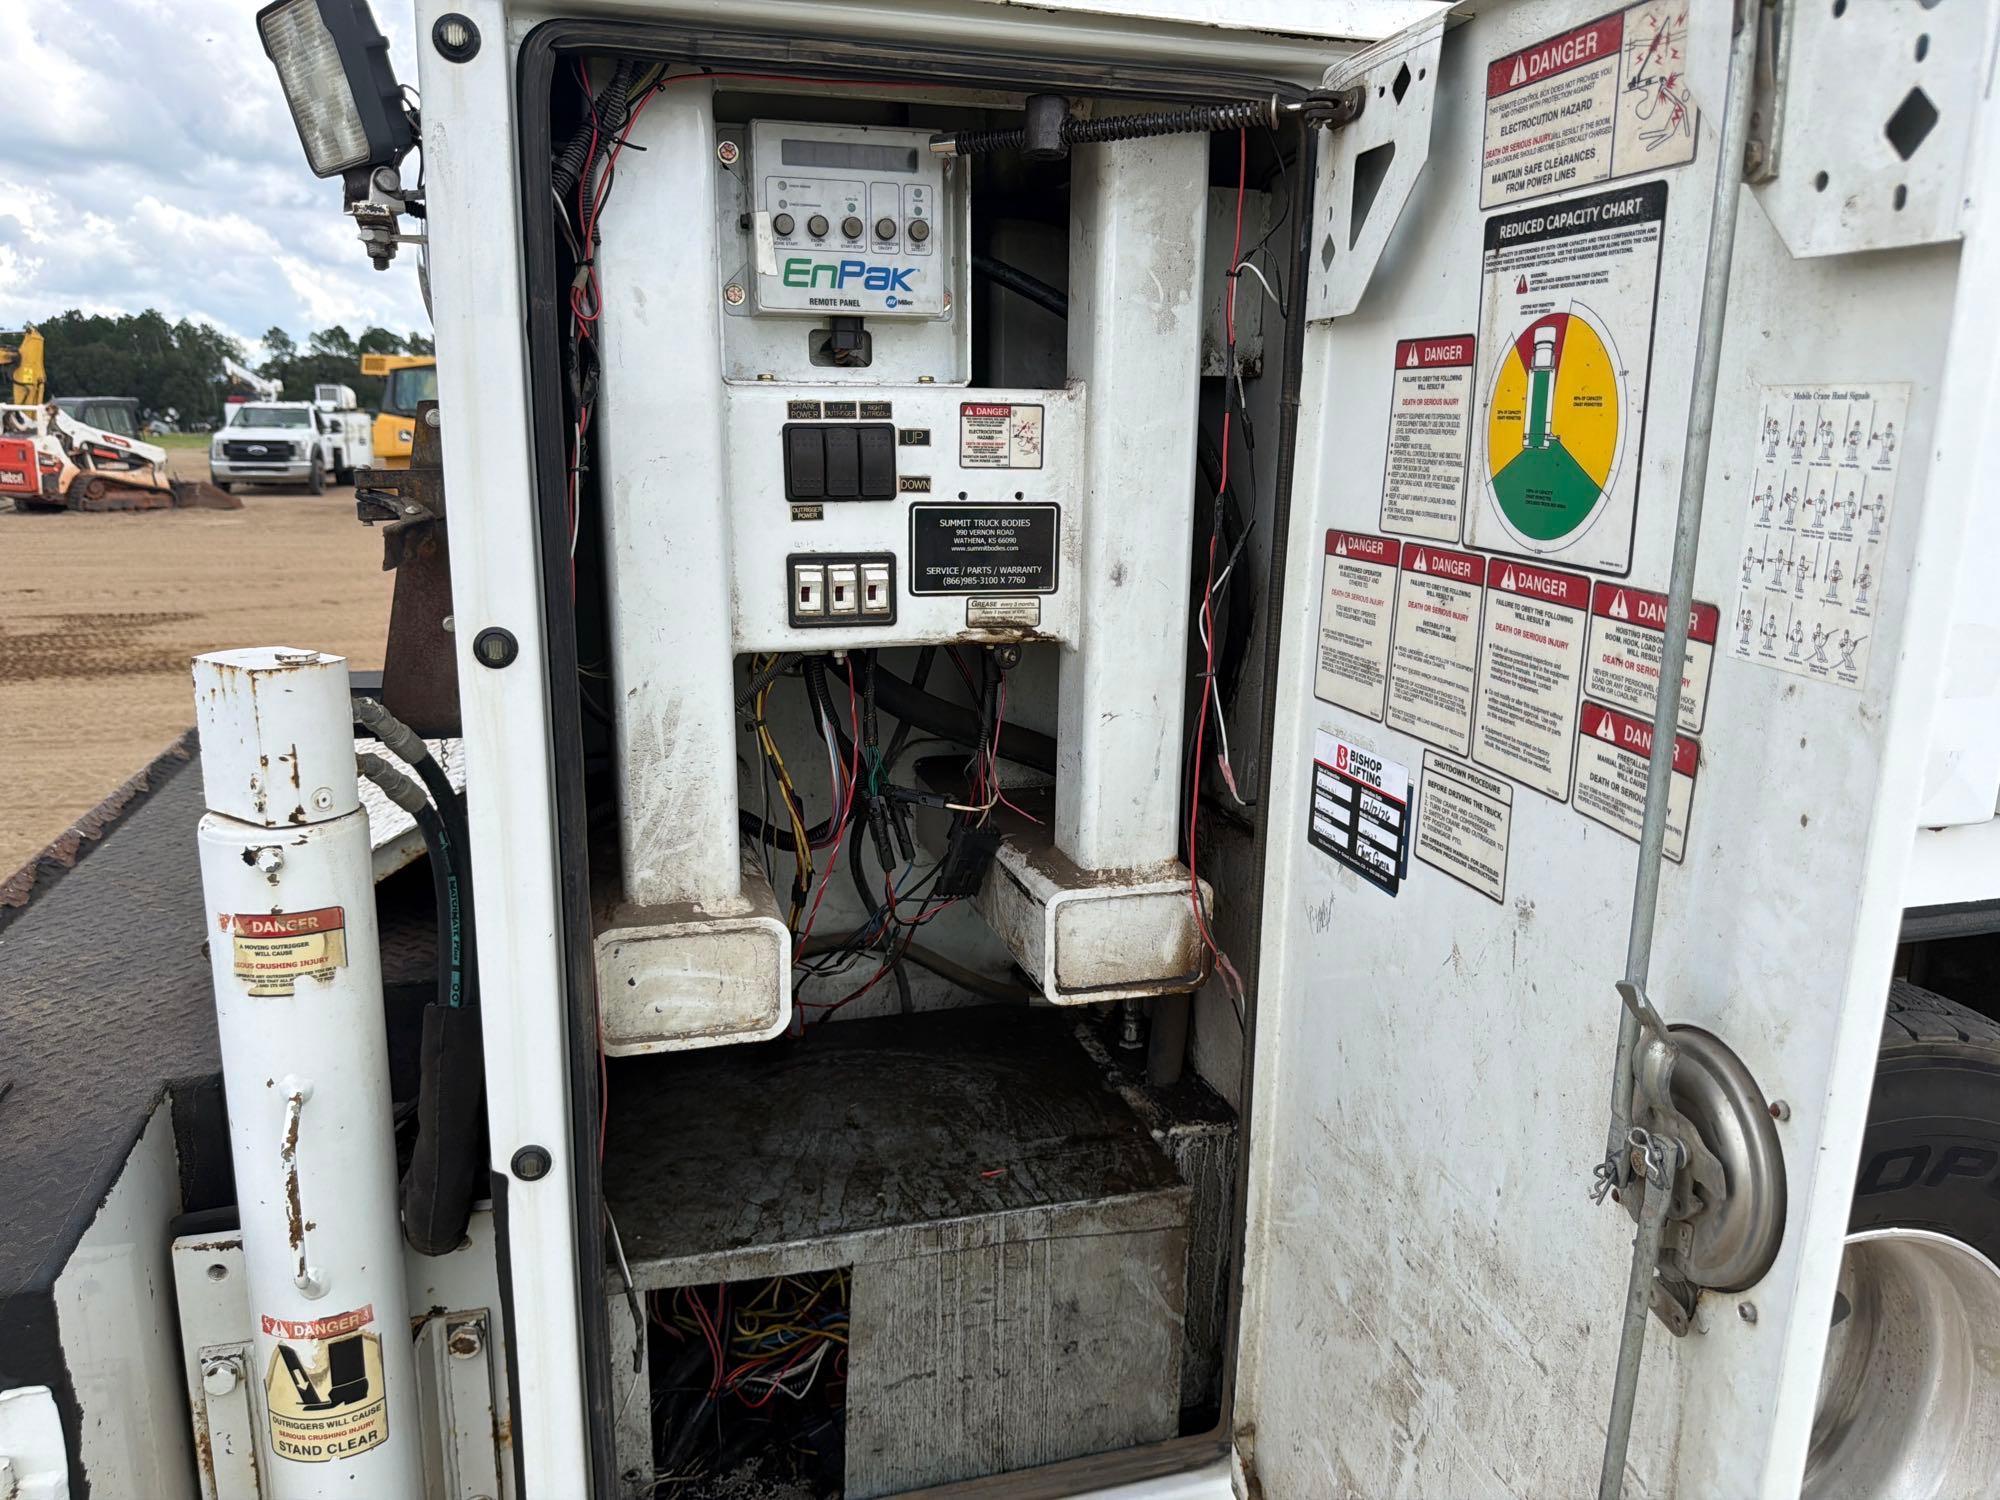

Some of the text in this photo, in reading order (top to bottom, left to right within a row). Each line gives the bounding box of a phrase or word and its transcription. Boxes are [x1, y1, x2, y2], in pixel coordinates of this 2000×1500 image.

[1529, 30, 1598, 76] DANGER
[1500, 97, 1592, 137] ELECTROCUTION HAZARD
[1485, 137, 1531, 159] DEATH OR SERIOUS
[1491, 146, 1595, 184] MAINTAIN SAFE CLEARANCES
[1505, 180, 1525, 194] FROM
[1526, 172, 1553, 189] POWER
[1554, 166, 1576, 182] LINES
[1499, 196, 1643, 240] REDUCED CAPACITY CHART
[783, 258, 916, 292] EnPak
[809, 298, 861, 307] REMOTE PANEL
[1423, 345, 1463, 361] DANGER
[1793, 391, 1870, 401] Mobile Crane Hand Signals
[905, 432, 923, 444] UP
[900, 480, 930, 489] DOWN
[1347, 536, 1383, 555] DANGER
[926, 567, 959, 575] SERVICE
[1000, 566, 1042, 574] WARRANTY
[1431, 556, 1471, 577] DANGER
[943, 576, 998, 586] (866)985-3100
[1008, 576, 1026, 584] 7760
[1517, 572, 1567, 598] DANGER
[1407, 600, 1468, 622] DEATH OR SERIOUS INJURY
[1495, 597, 1573, 625] FAILURE TO OBEY THE FOLLOWING
[1514, 611, 1525, 621] WILL
[1525, 614, 1543, 626] RESULT
[1637, 600, 1699, 630] DANR
[1495, 622, 1568, 651] DEATH OR SERIOUS INJURY
[1604, 632, 1656, 653] BOOM, HOOK, LOAD
[1615, 626, 1640, 639] HOISTING
[1602, 653, 1660, 678] DEATH OR SERIOU
[1626, 647, 1661, 664] WILL RESULT
[1624, 677, 1654, 692] PERSONNEL
[1623, 724, 1680, 761] DANR
[1349, 749, 1382, 774] BISHOP
[1597, 753, 1617, 768] MANUAL
[1348, 762, 1381, 788] LIFTING
[1433, 758, 1500, 794] SHUTDOWN PROCEDURE
[1589, 771, 1609, 788] DEATH
[1610, 781, 1620, 793] OR
[1616, 771, 1646, 790] WILL CAUSE
[1427, 779, 1502, 821] BEFORE DRIVING THE TRUCK,
[252, 917, 319, 933] DANGER
[271, 941, 309, 950] OUTRIGGER
[300, 957, 329, 967] INJURY
[294, 1314, 359, 1337] DANGER
[272, 1403, 382, 1430] OUTRIGGERS WILL CAUSE
[278, 1420, 375, 1441] SERIOUS CRUSHING INJURY
[279, 1430, 378, 1456] STAND CLEAR
